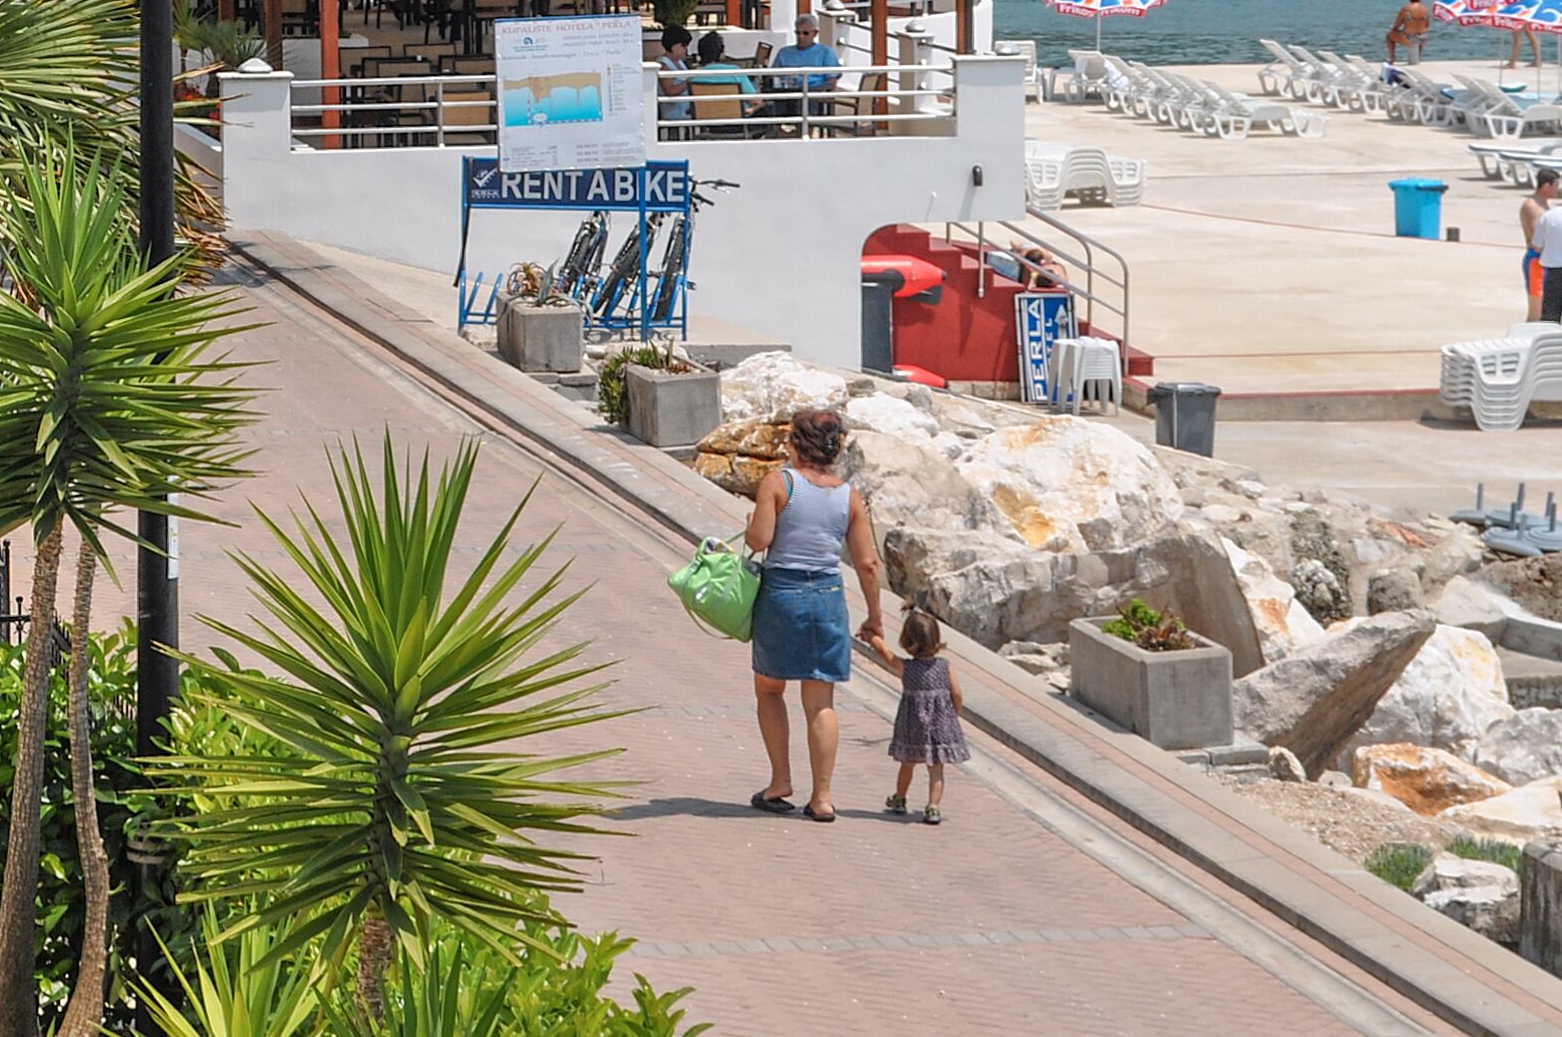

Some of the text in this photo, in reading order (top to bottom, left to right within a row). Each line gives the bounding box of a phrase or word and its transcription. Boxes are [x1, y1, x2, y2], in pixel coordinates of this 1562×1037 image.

[501, 169, 685, 203] RENT A BIKE
[1028, 299, 1049, 402] PERLA
